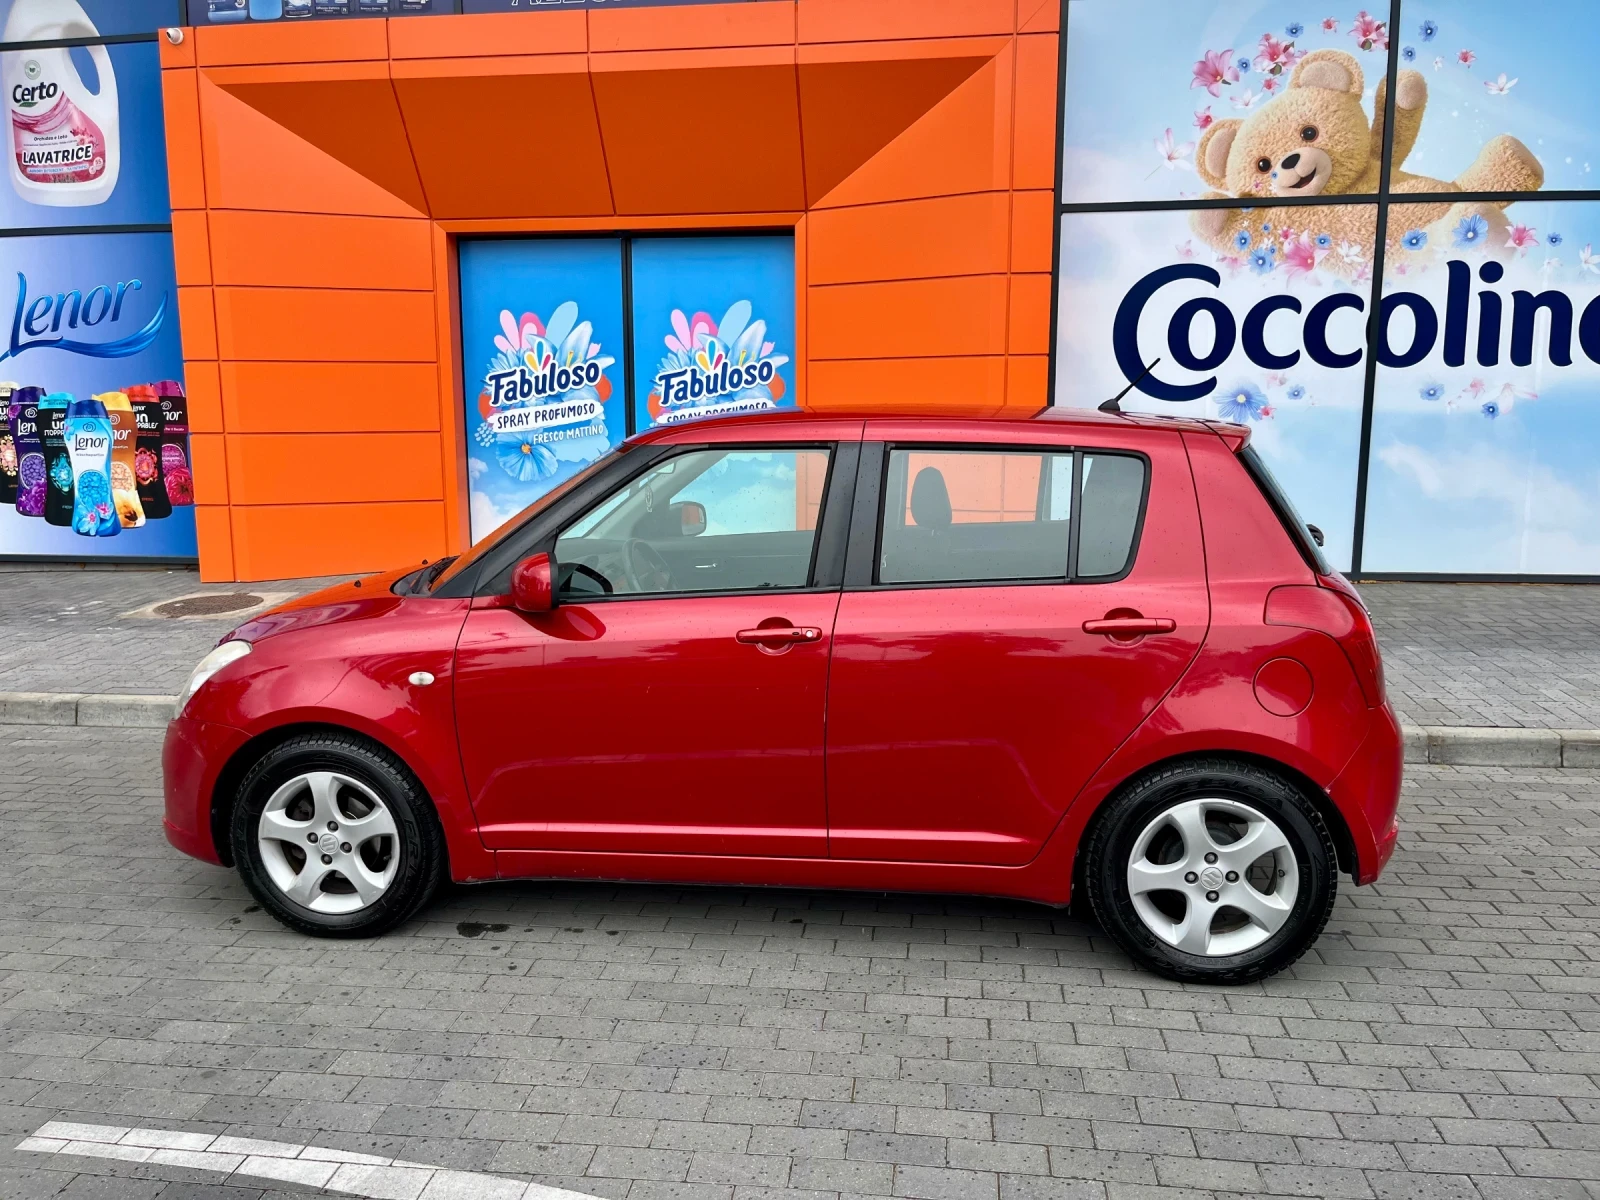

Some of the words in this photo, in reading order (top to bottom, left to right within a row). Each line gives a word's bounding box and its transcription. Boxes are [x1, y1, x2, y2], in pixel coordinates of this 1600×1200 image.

[13, 82, 58, 103] Certo
[23, 146, 92, 164] LAVATRICE
[10, 271, 142, 357] Lenor
[488, 362, 600, 405] Fabuloso
[658, 361, 773, 405] Fabuloso
[163, 411, 182, 420] nor
[497, 412, 530, 429] SPRAY
[534, 402, 595, 423] PROFUMOSO
[75, 434, 107, 452] Lenor
[113, 430, 131, 440] nor
[533, 431, 564, 445] FRESCO
[566, 424, 604, 440] MATTINO
